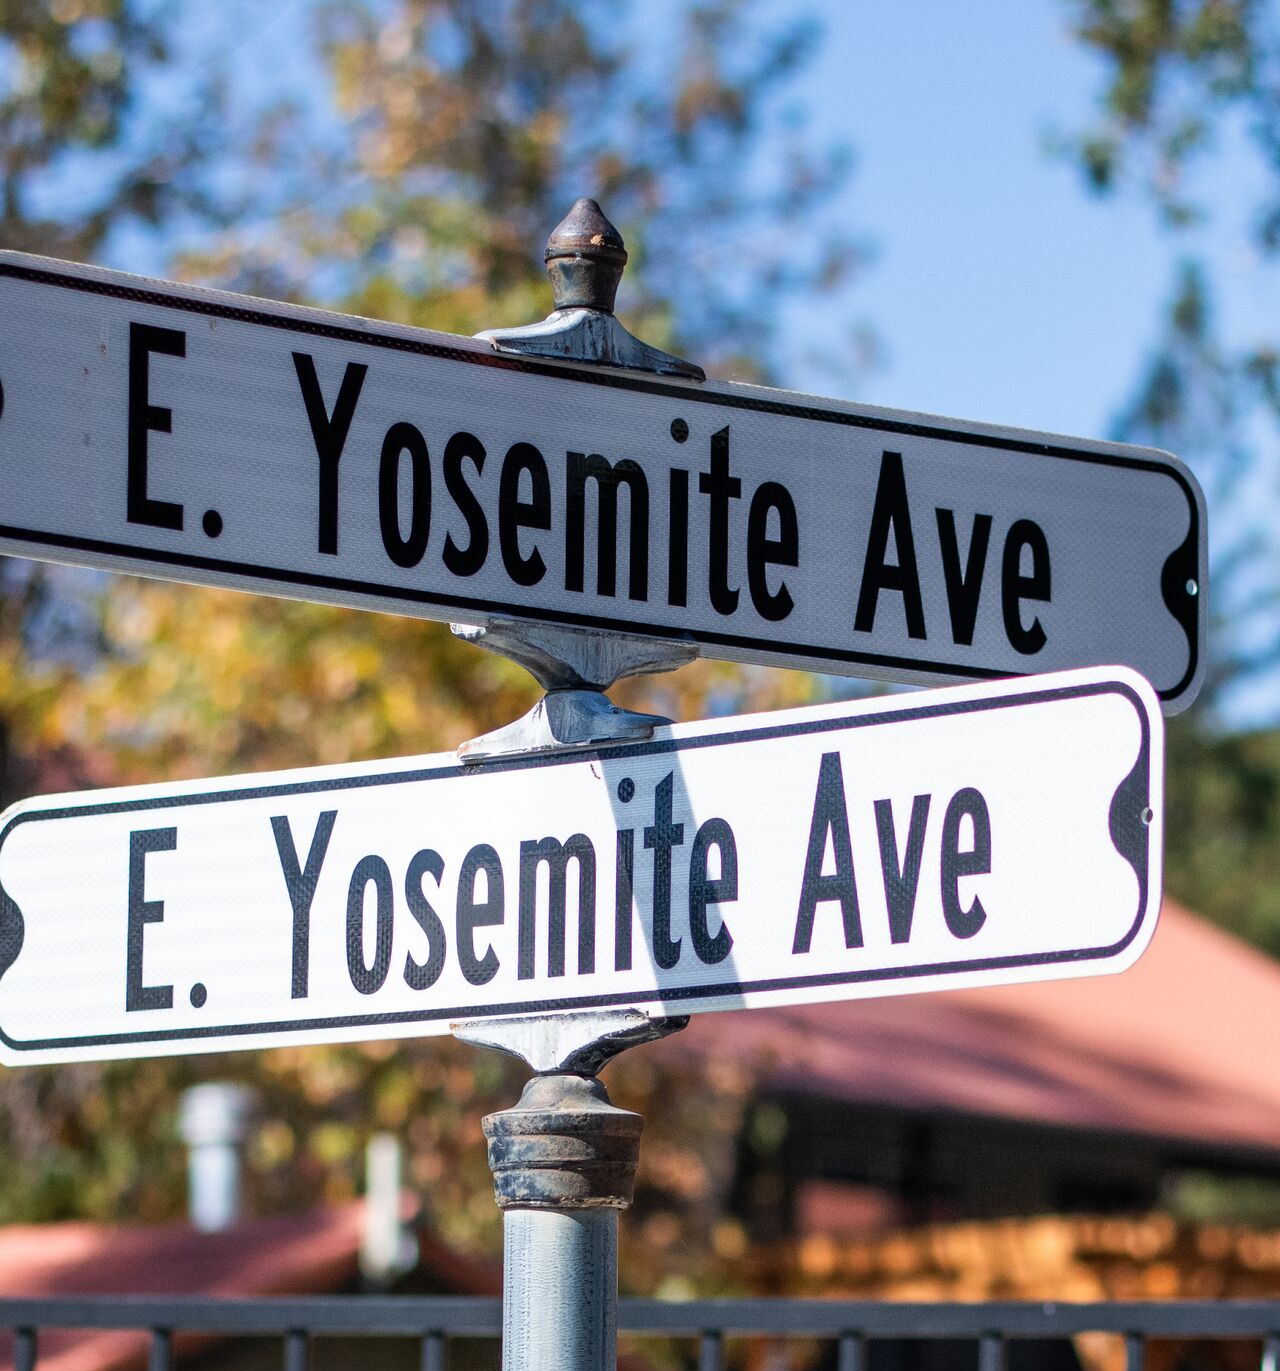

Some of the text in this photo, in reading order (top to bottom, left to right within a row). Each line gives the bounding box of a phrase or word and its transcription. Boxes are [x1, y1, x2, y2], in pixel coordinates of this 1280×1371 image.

[126, 321, 1053, 656] E. Yosemite Ave
[124, 750, 993, 1014] E. Yosemite Ave
